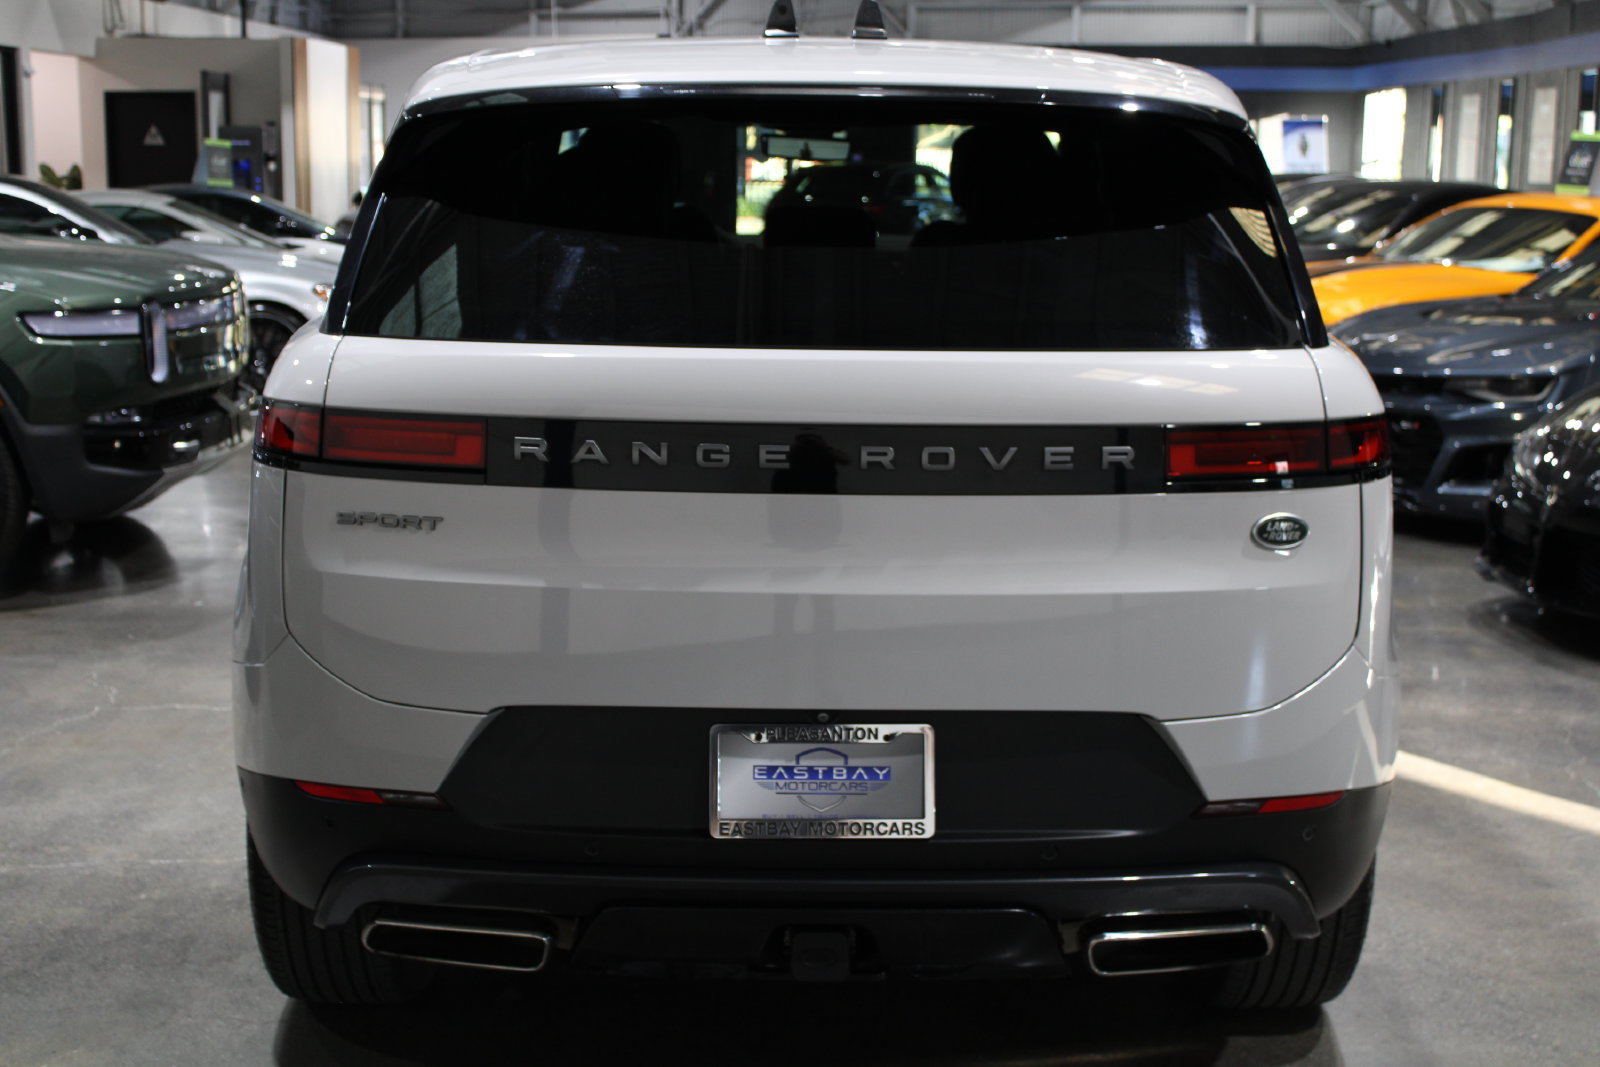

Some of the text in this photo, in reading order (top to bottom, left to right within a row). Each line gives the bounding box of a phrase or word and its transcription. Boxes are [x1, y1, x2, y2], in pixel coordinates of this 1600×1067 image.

[514, 436, 1135, 471] RANGE ROVER
[336, 511, 444, 531] SPORT
[765, 727, 879, 741] PLEASANTON
[754, 766, 890, 780] EASTBAY
[774, 781, 869, 791] MOTORCARS
[719, 822, 926, 836] EASTBAY MOTORCARS
